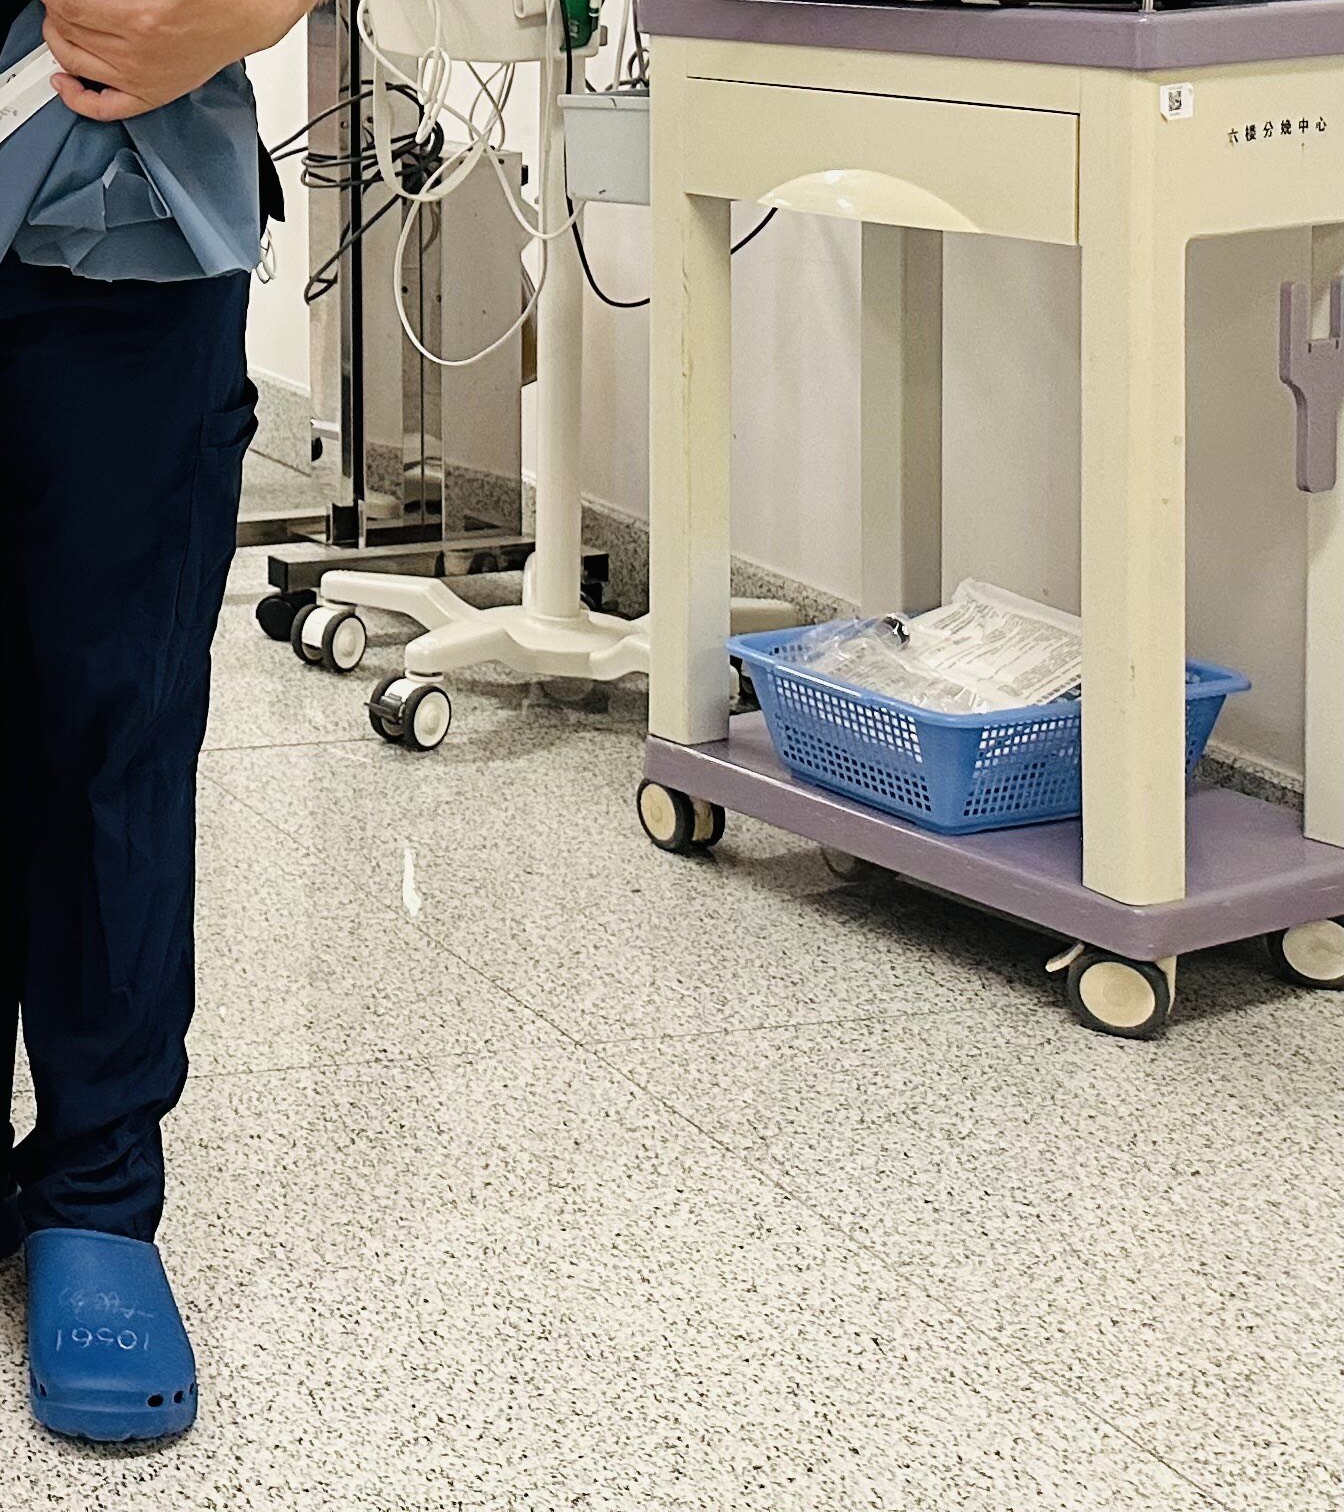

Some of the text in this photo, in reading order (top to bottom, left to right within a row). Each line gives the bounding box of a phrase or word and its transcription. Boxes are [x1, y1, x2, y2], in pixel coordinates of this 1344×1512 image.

[1227, 115, 1328, 144] 六楼分娩中心
